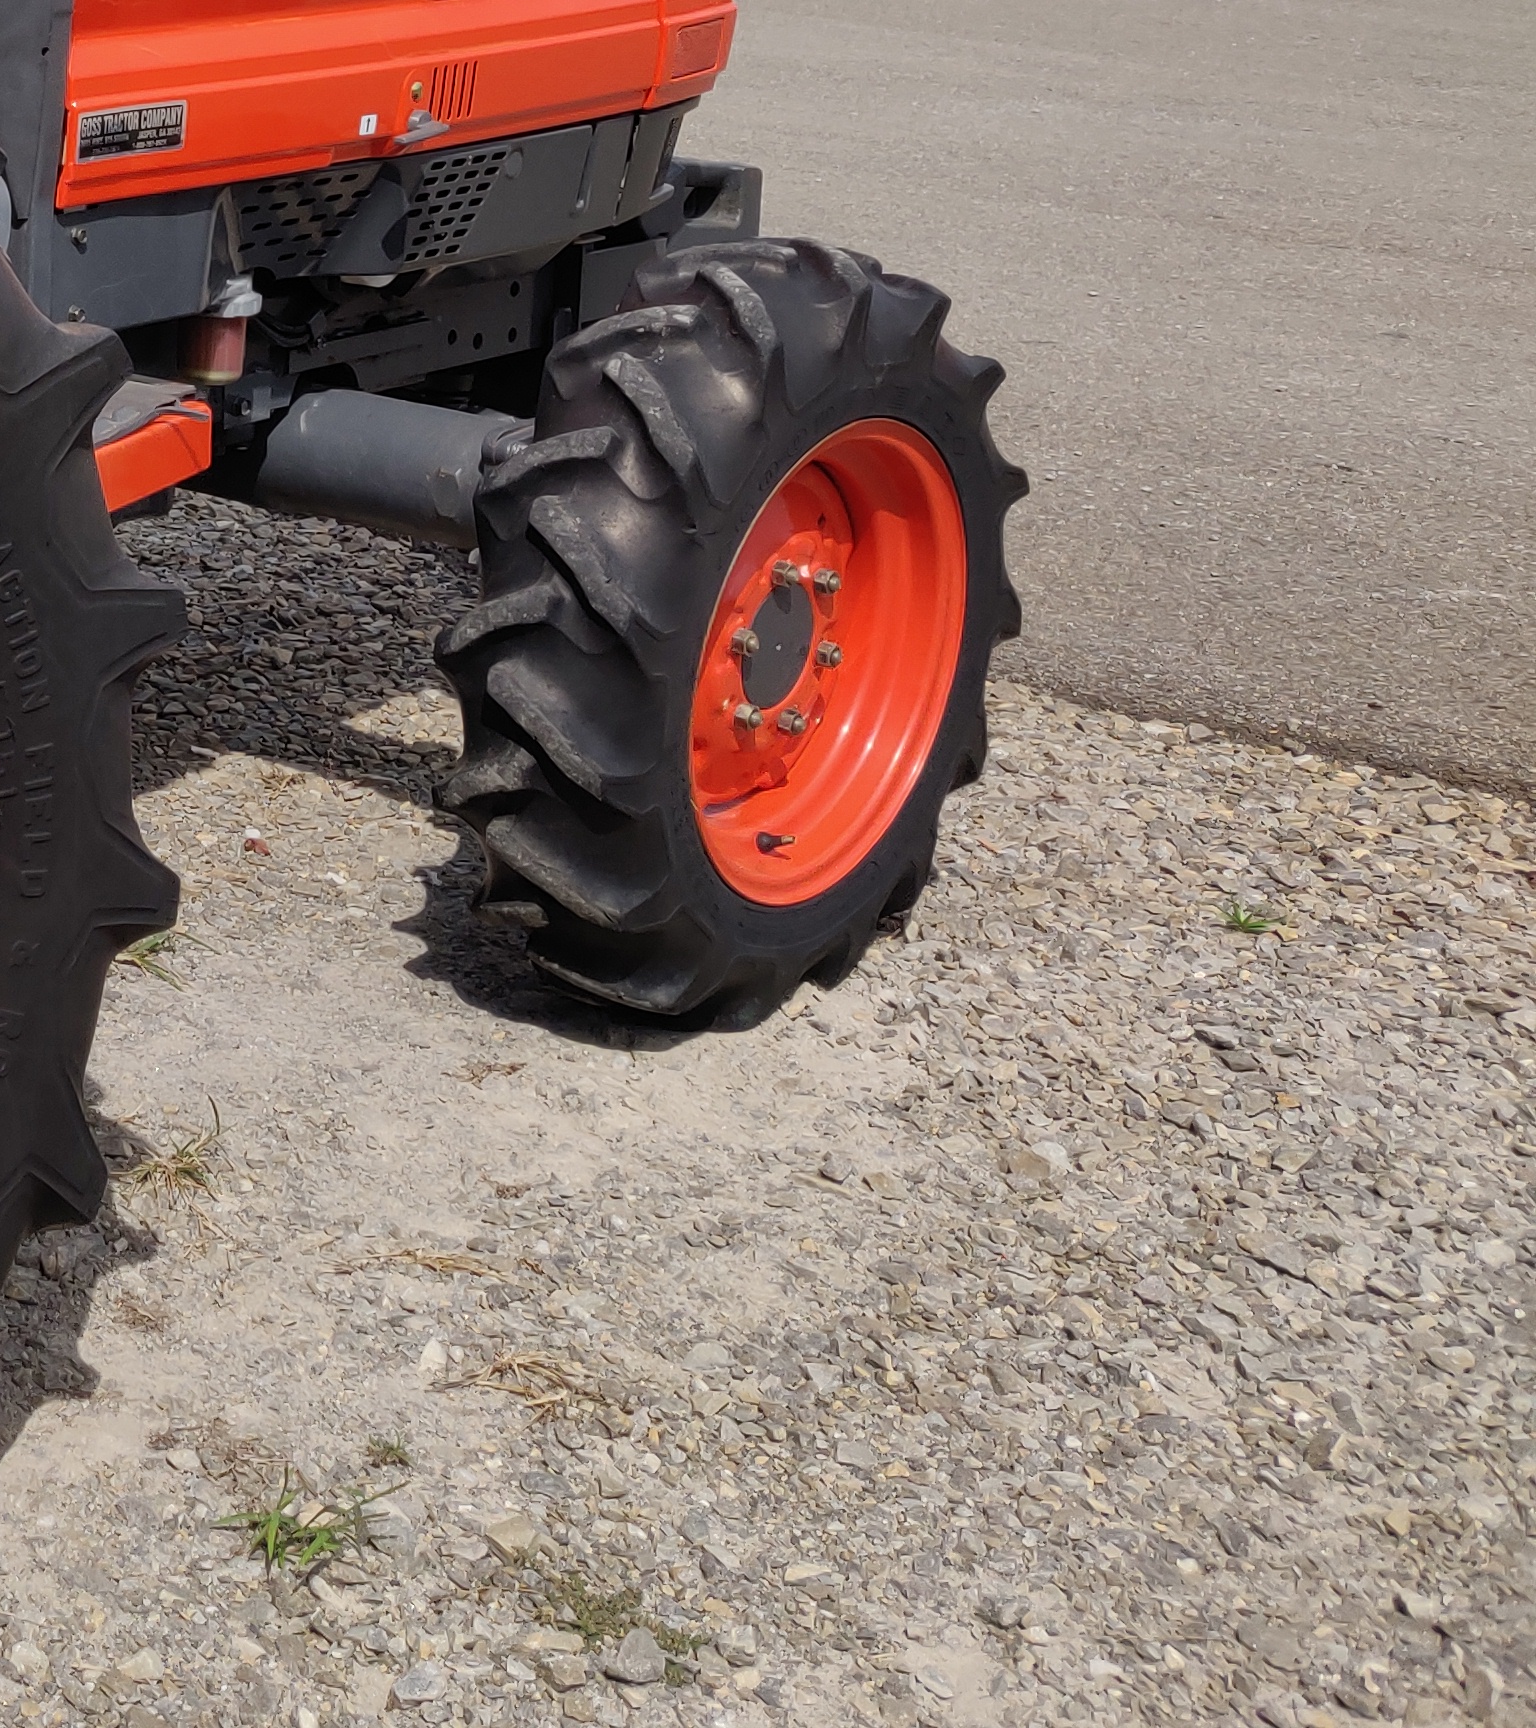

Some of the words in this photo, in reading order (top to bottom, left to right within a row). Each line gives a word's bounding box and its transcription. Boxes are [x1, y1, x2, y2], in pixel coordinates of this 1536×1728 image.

[81, 116, 102, 139] GOSS
[103, 111, 140, 135] TRACTOR
[140, 105, 183, 130] COMPANY
[19, 739, 57, 902] FIELD
